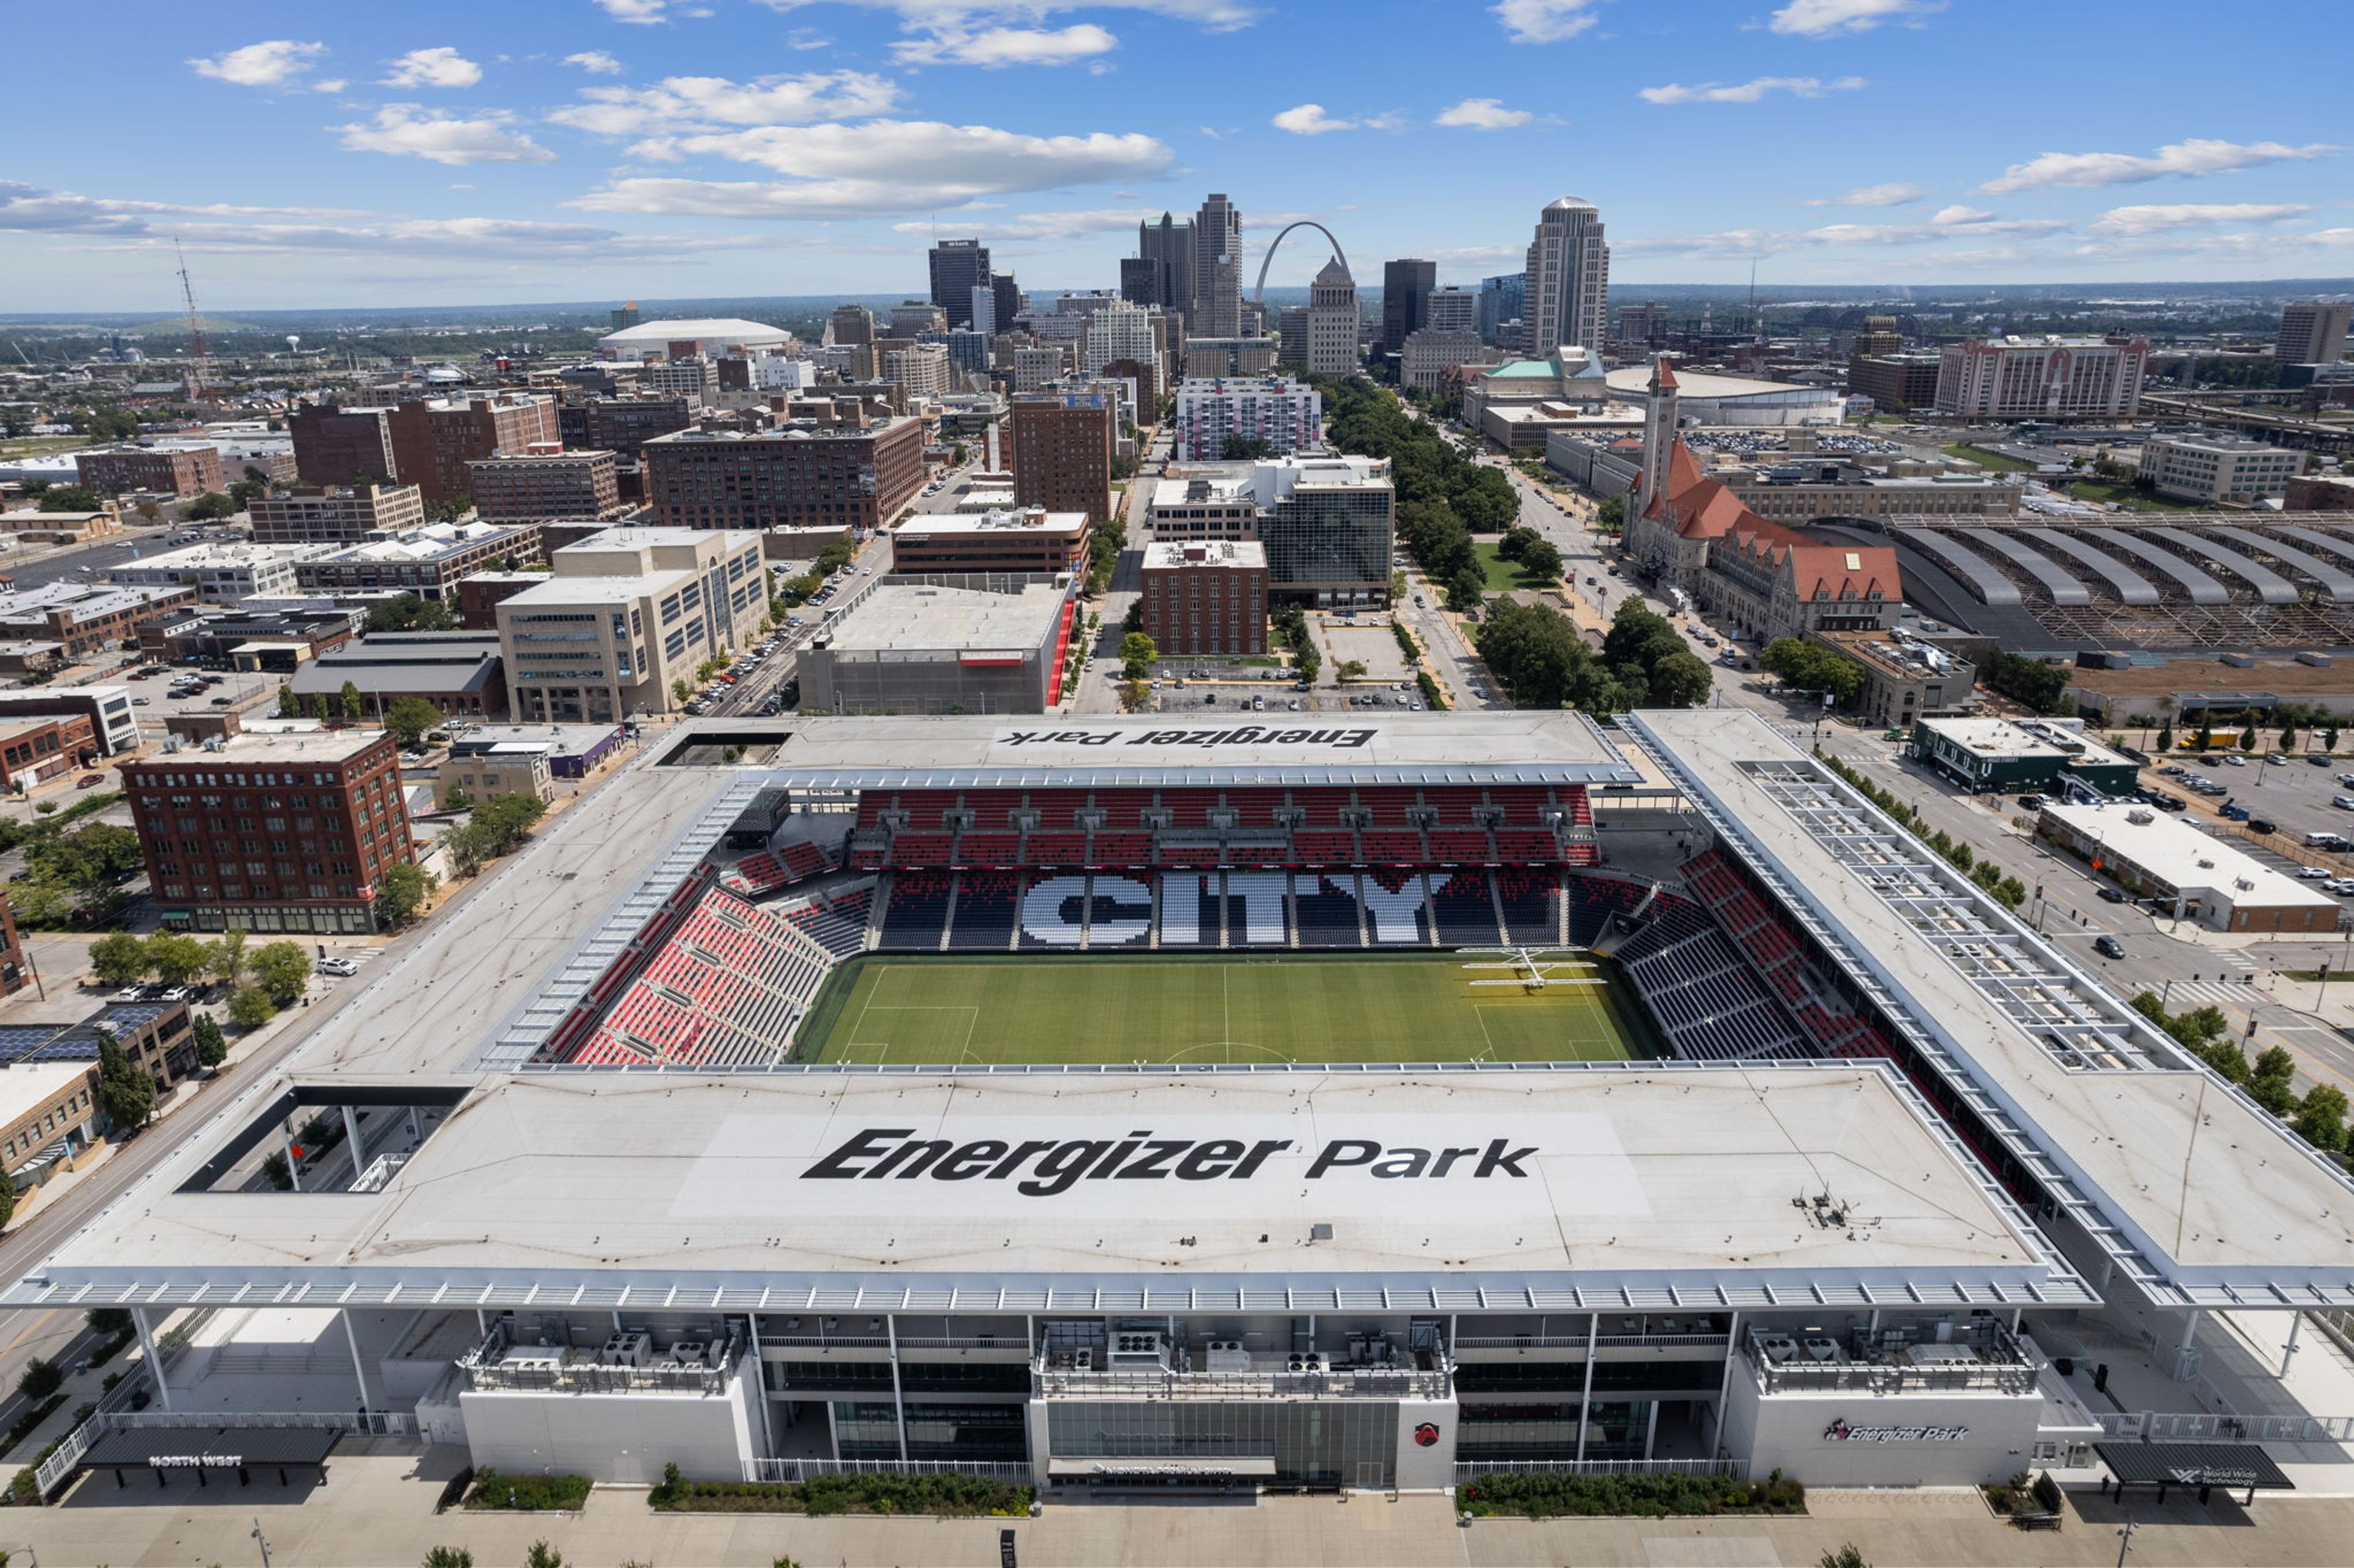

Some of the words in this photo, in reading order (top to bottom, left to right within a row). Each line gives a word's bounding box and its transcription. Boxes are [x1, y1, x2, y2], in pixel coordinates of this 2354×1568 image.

[999, 731, 1122, 746] Park
[1126, 726, 1377, 748] Energizer
[1022, 873, 1452, 945] CITY
[799, 1128, 1293, 1197] Energizer
[1305, 1139, 1539, 1180] Park
[1846, 1426, 1927, 1444] Energizer
[1921, 1427, 1968, 1441] Park
[149, 1455, 200, 1467] NORTH
[200, 1455, 242, 1467] WEST
[2202, 1477, 2255, 1486] Technology
